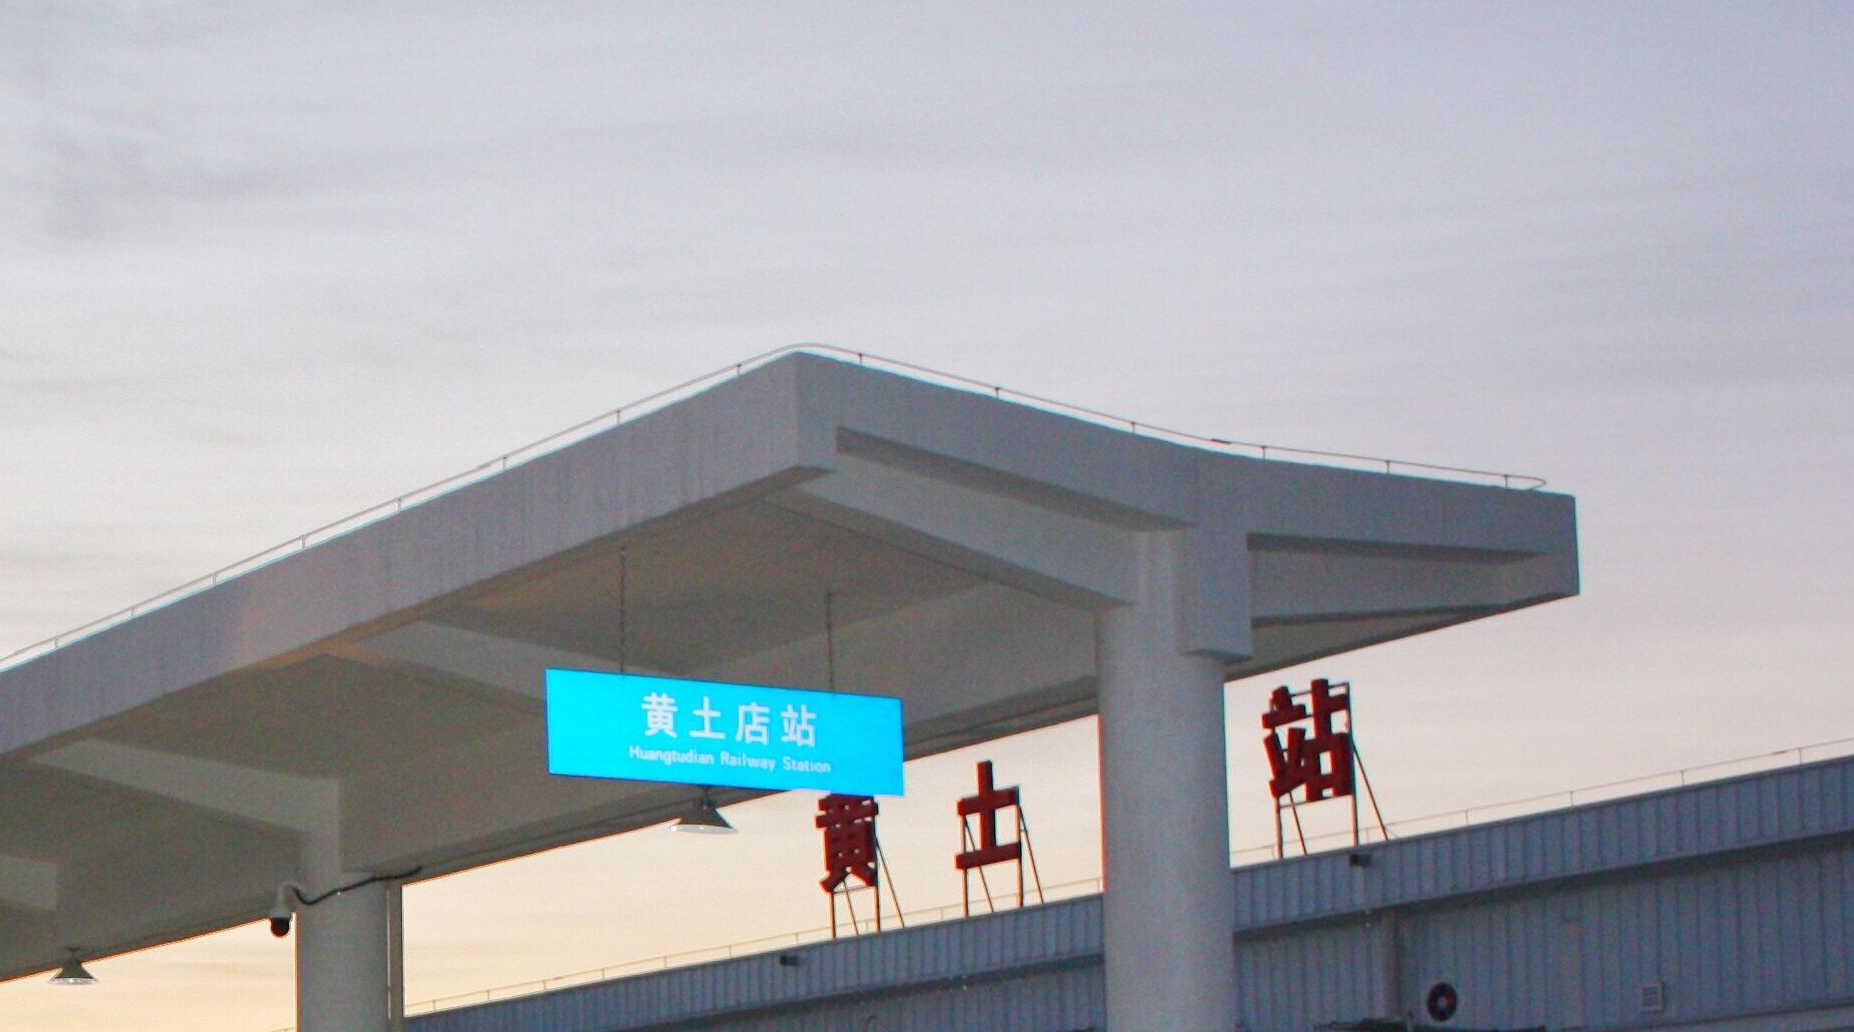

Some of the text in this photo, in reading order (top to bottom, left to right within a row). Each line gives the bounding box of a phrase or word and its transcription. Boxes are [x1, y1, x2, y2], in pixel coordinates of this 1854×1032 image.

[640, 692, 818, 748] 黄土店站
[628, 745, 832, 773] Huangtudian Railway Station
